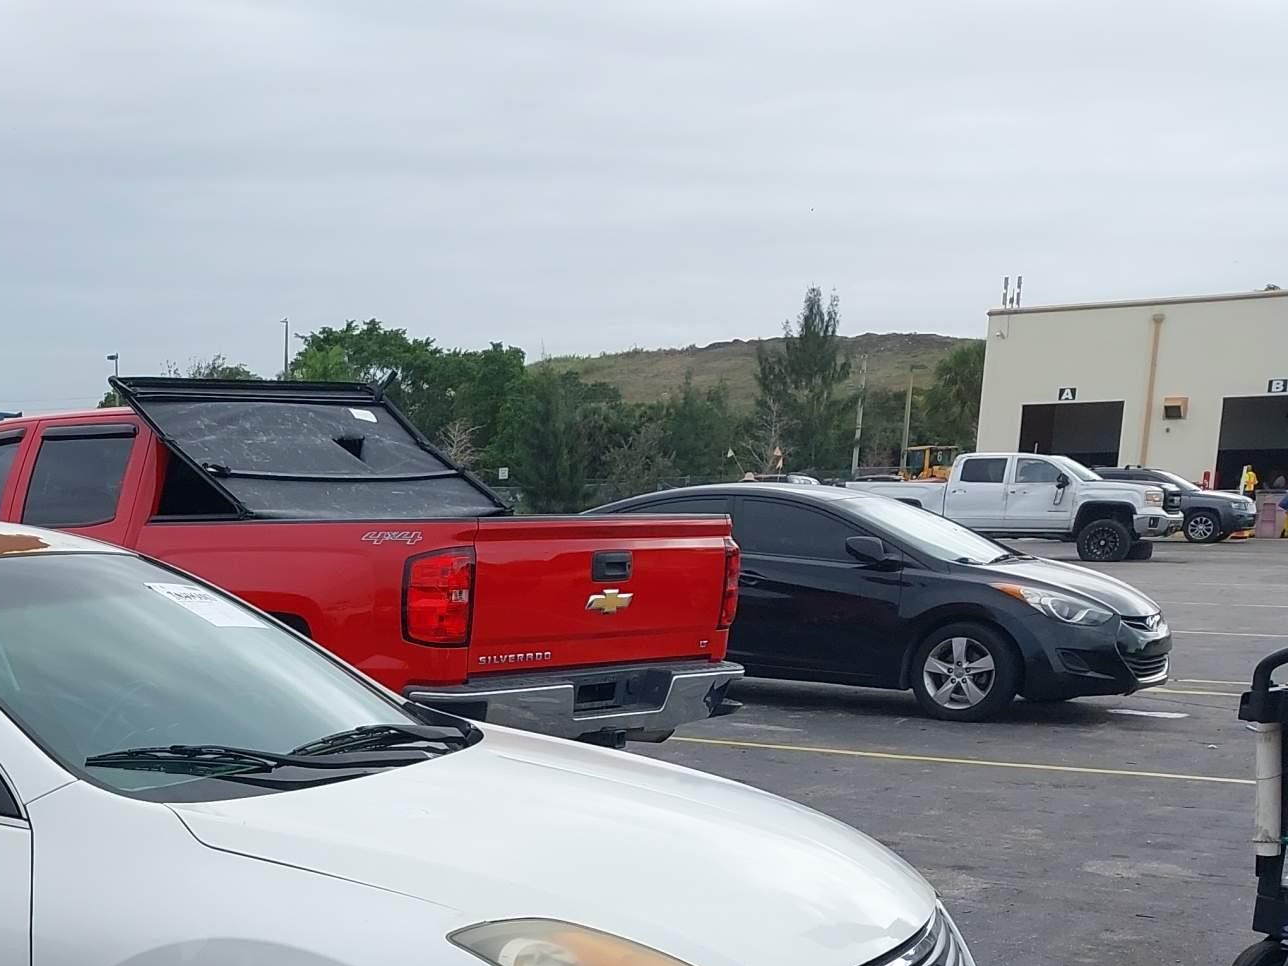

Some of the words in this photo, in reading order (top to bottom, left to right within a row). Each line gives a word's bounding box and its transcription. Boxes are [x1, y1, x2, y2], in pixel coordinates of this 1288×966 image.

[1271, 380, 1285, 392] B
[1061, 388, 1073, 400] A
[478, 651, 552, 665] SILVERADO
